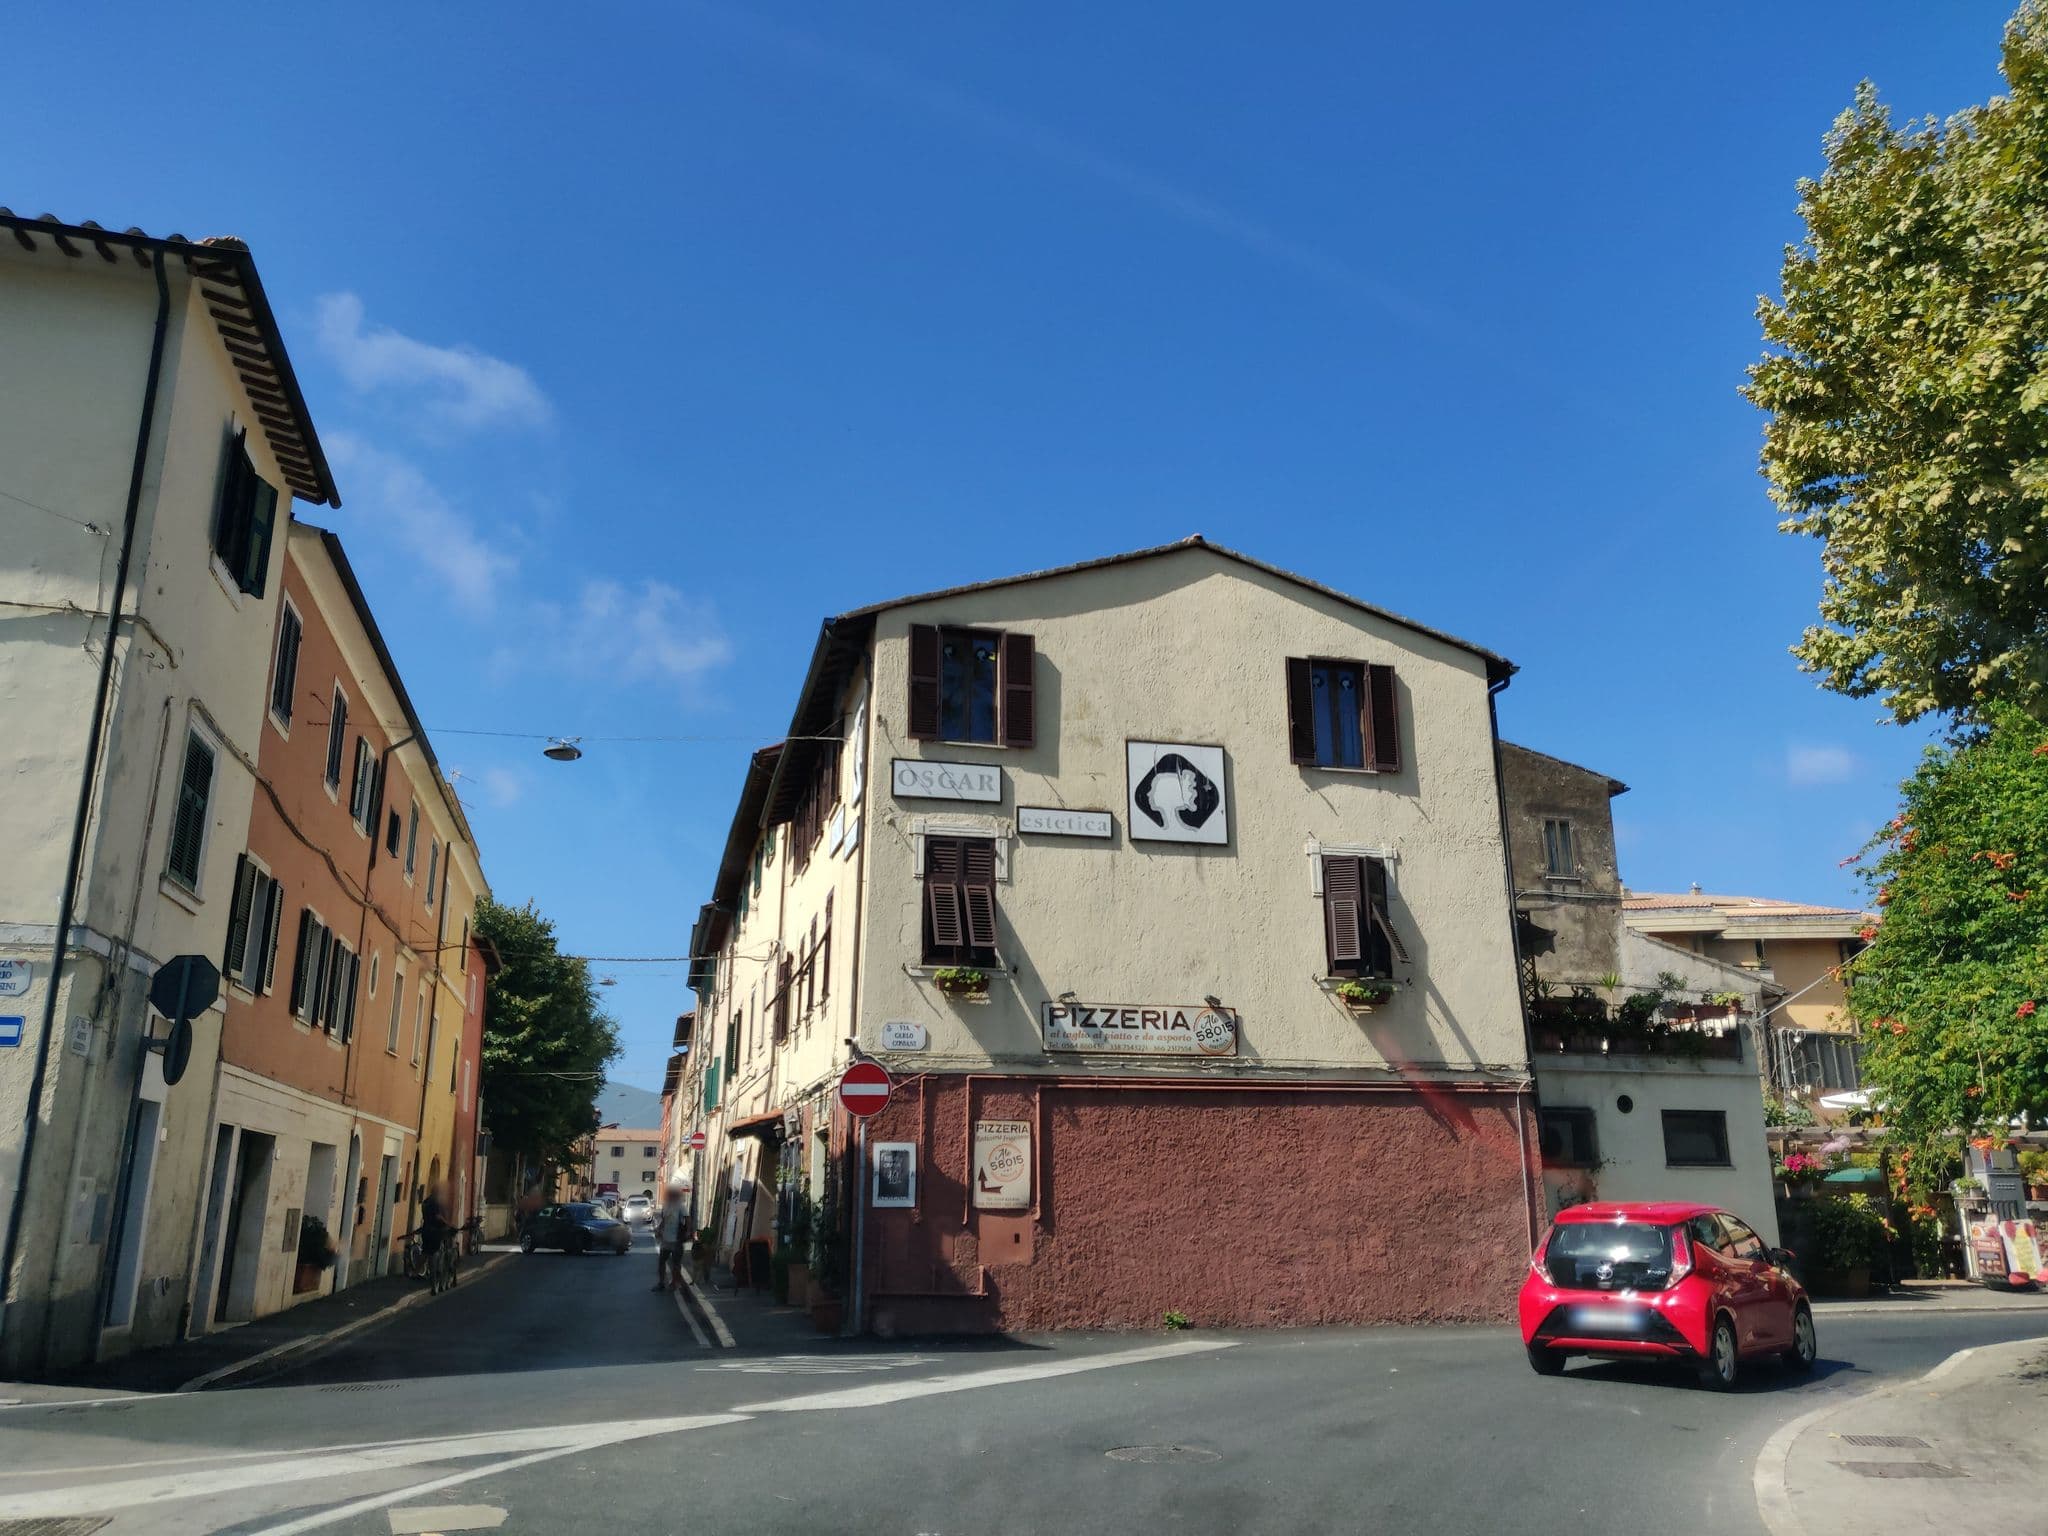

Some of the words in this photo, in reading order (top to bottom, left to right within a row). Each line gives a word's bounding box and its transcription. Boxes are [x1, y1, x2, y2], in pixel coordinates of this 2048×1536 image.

[898, 769, 996, 792] OSCAR
[1021, 816, 1107, 832] estetica
[0, 960, 12, 968] ZA
[1049, 1007, 1191, 1030] PIZZERIA
[1050, 1030, 1059, 1038] al
[1062, 1030, 1090, 1041] taglio
[1092, 1030, 1102, 1039] al
[1104, 1031, 1132, 1042] piatto
[1143, 1032, 1154, 1040] da
[1157, 1034, 1192, 1043] asporto
[1196, 1021, 1235, 1042] 58015
[976, 1123, 1028, 1133] PIZZERIA
[990, 1154, 1024, 1171] 58015
